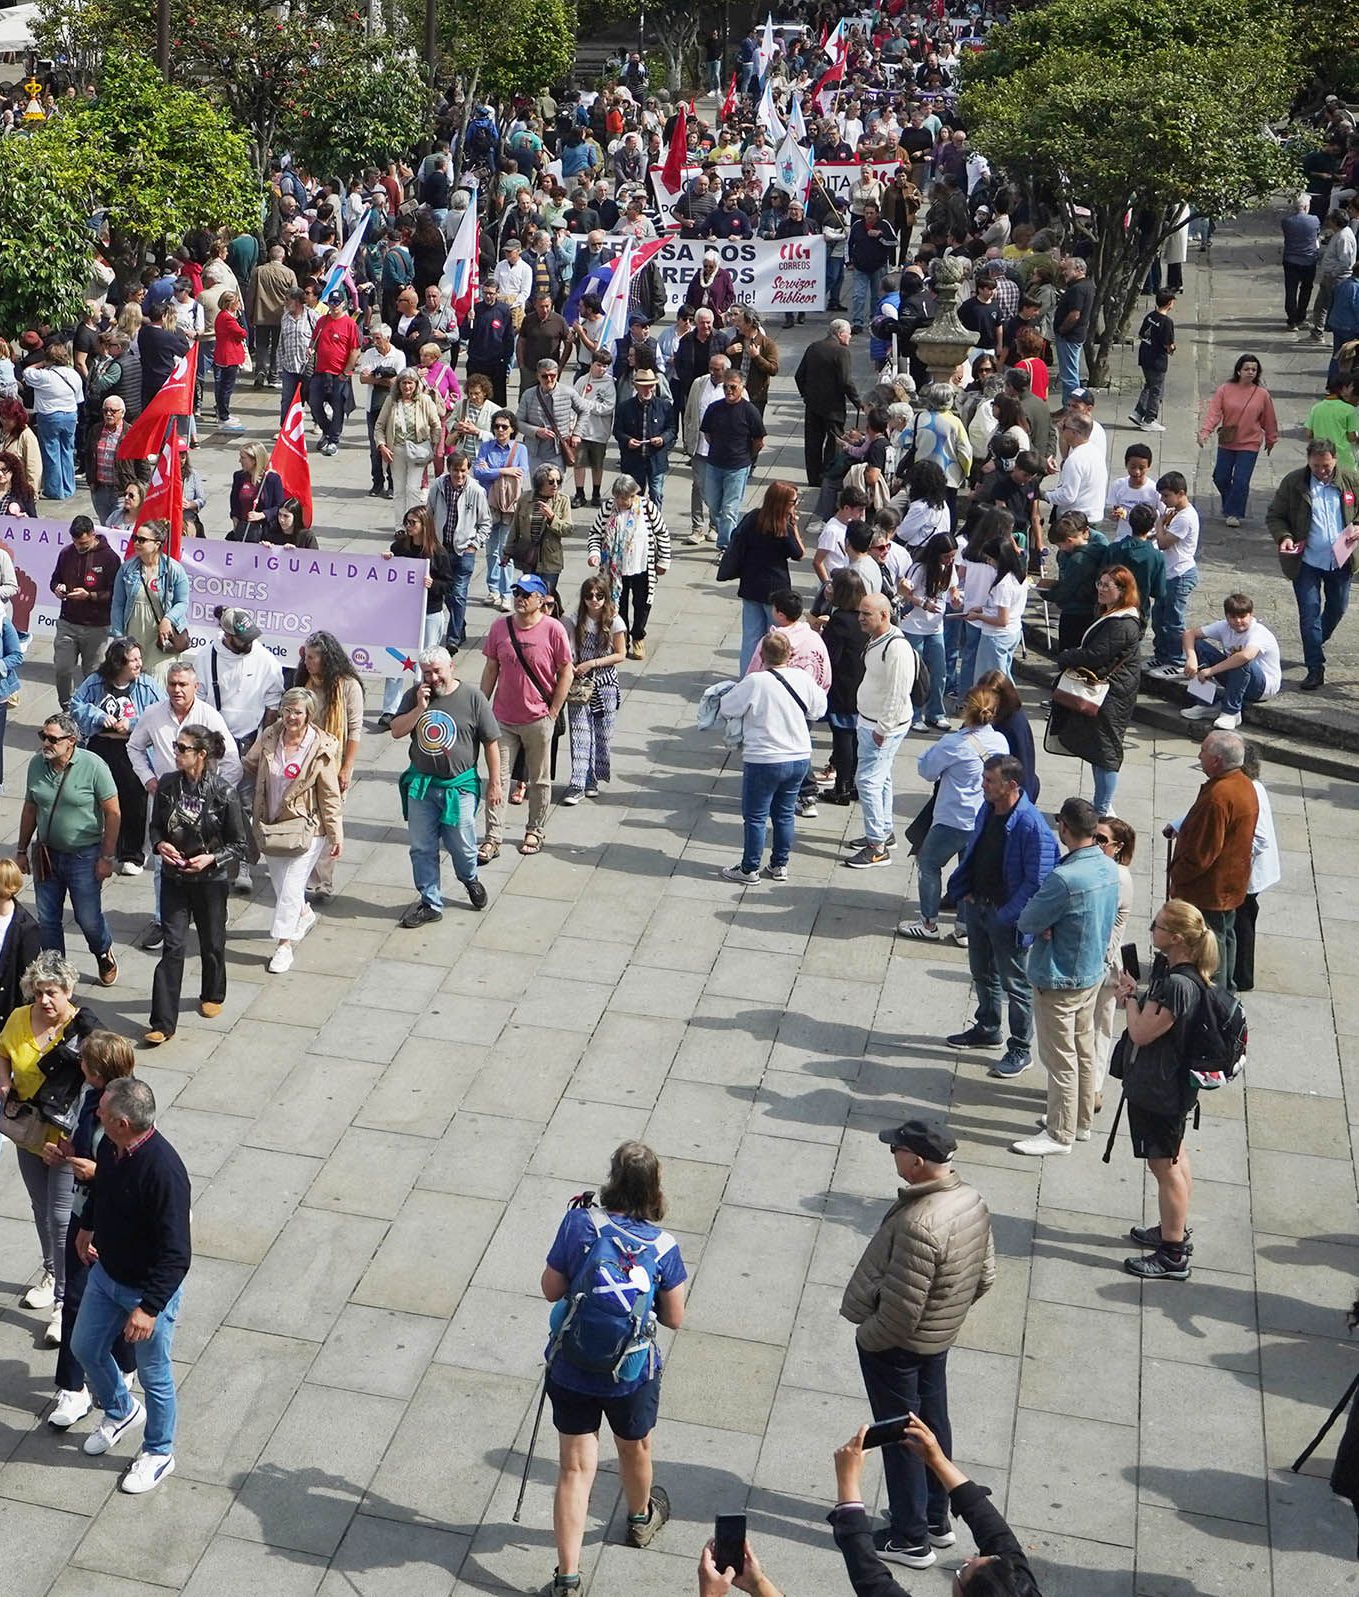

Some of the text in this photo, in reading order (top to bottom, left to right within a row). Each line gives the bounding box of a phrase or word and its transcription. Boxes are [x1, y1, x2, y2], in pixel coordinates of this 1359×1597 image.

[780, 243, 810, 260] CIG
[779, 261, 810, 270] CORREOS
[772, 276, 816, 291] Servizos
[225, 552, 233, 566] E
[254, 555, 417, 586] IGUALDADE
